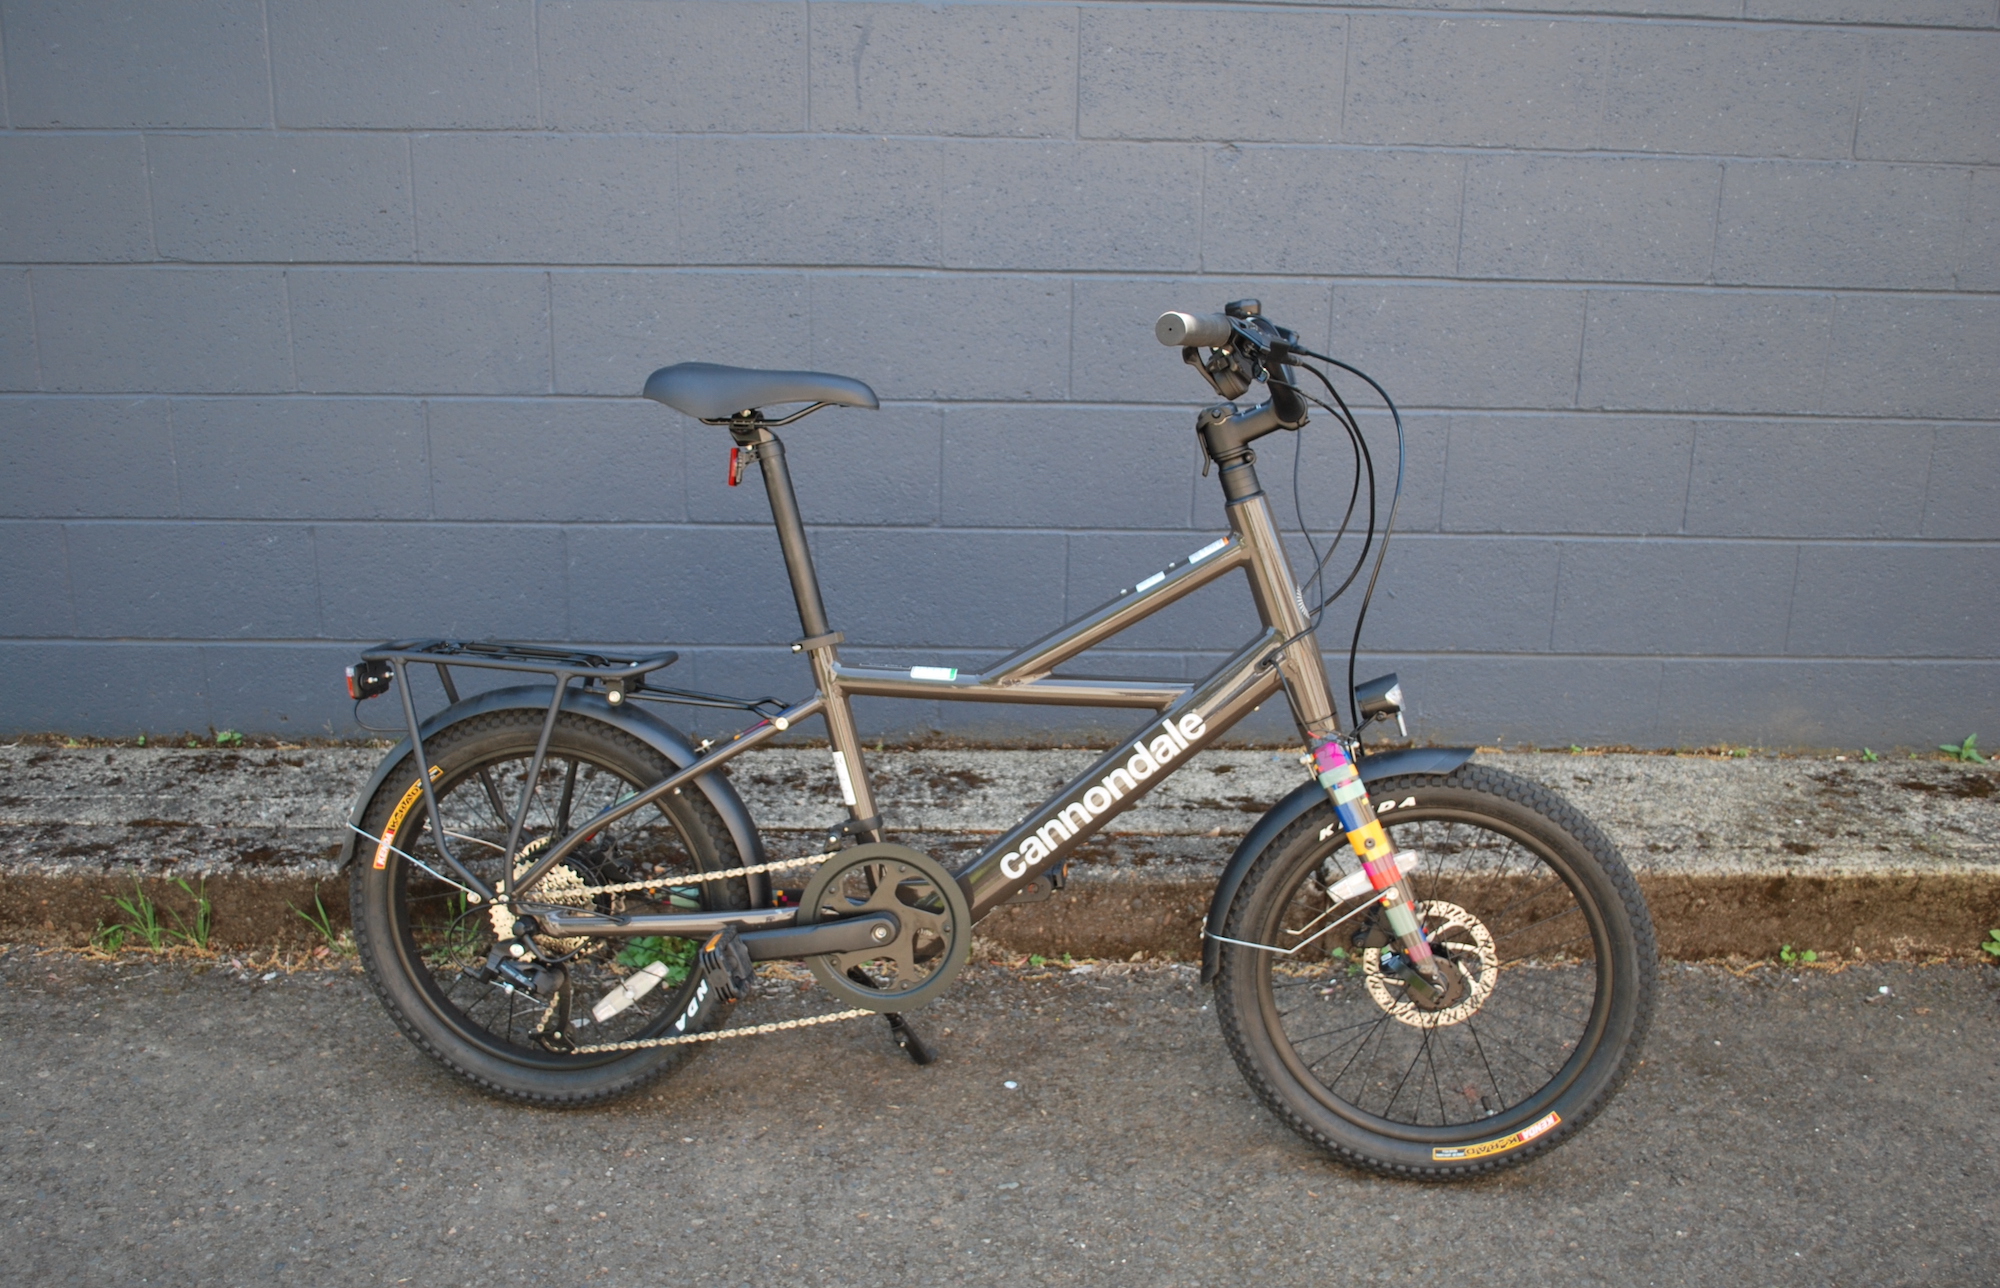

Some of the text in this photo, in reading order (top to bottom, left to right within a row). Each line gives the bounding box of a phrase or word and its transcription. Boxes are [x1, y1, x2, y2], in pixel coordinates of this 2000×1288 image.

[999, 712, 1207, 880] cannondale
[1318, 796, 1417, 842] KDA
[1522, 1114, 1555, 1140] KENDA
